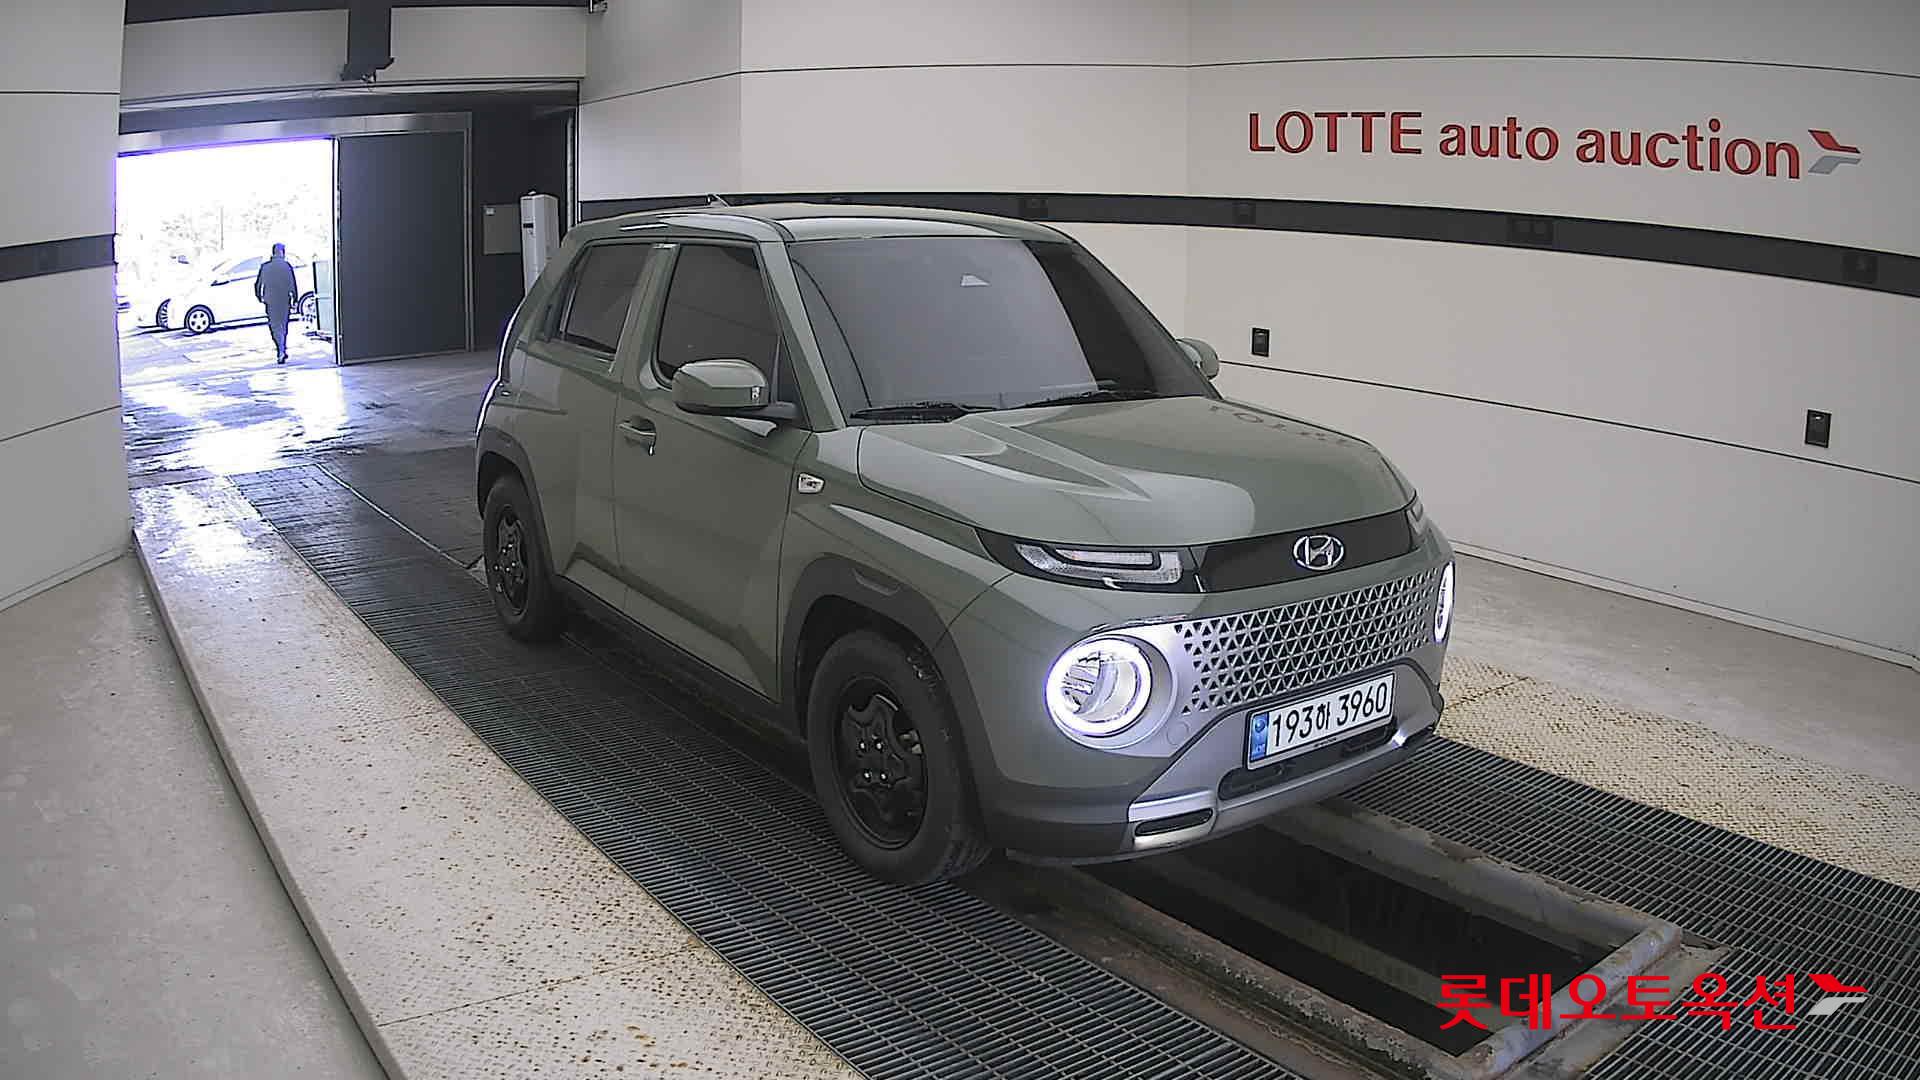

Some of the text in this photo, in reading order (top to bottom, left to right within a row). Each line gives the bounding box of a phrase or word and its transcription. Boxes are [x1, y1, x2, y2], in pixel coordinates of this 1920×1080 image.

[1249, 111, 1800, 179] LOTTE auto auction
[1337, 682, 1387, 726] 3960
